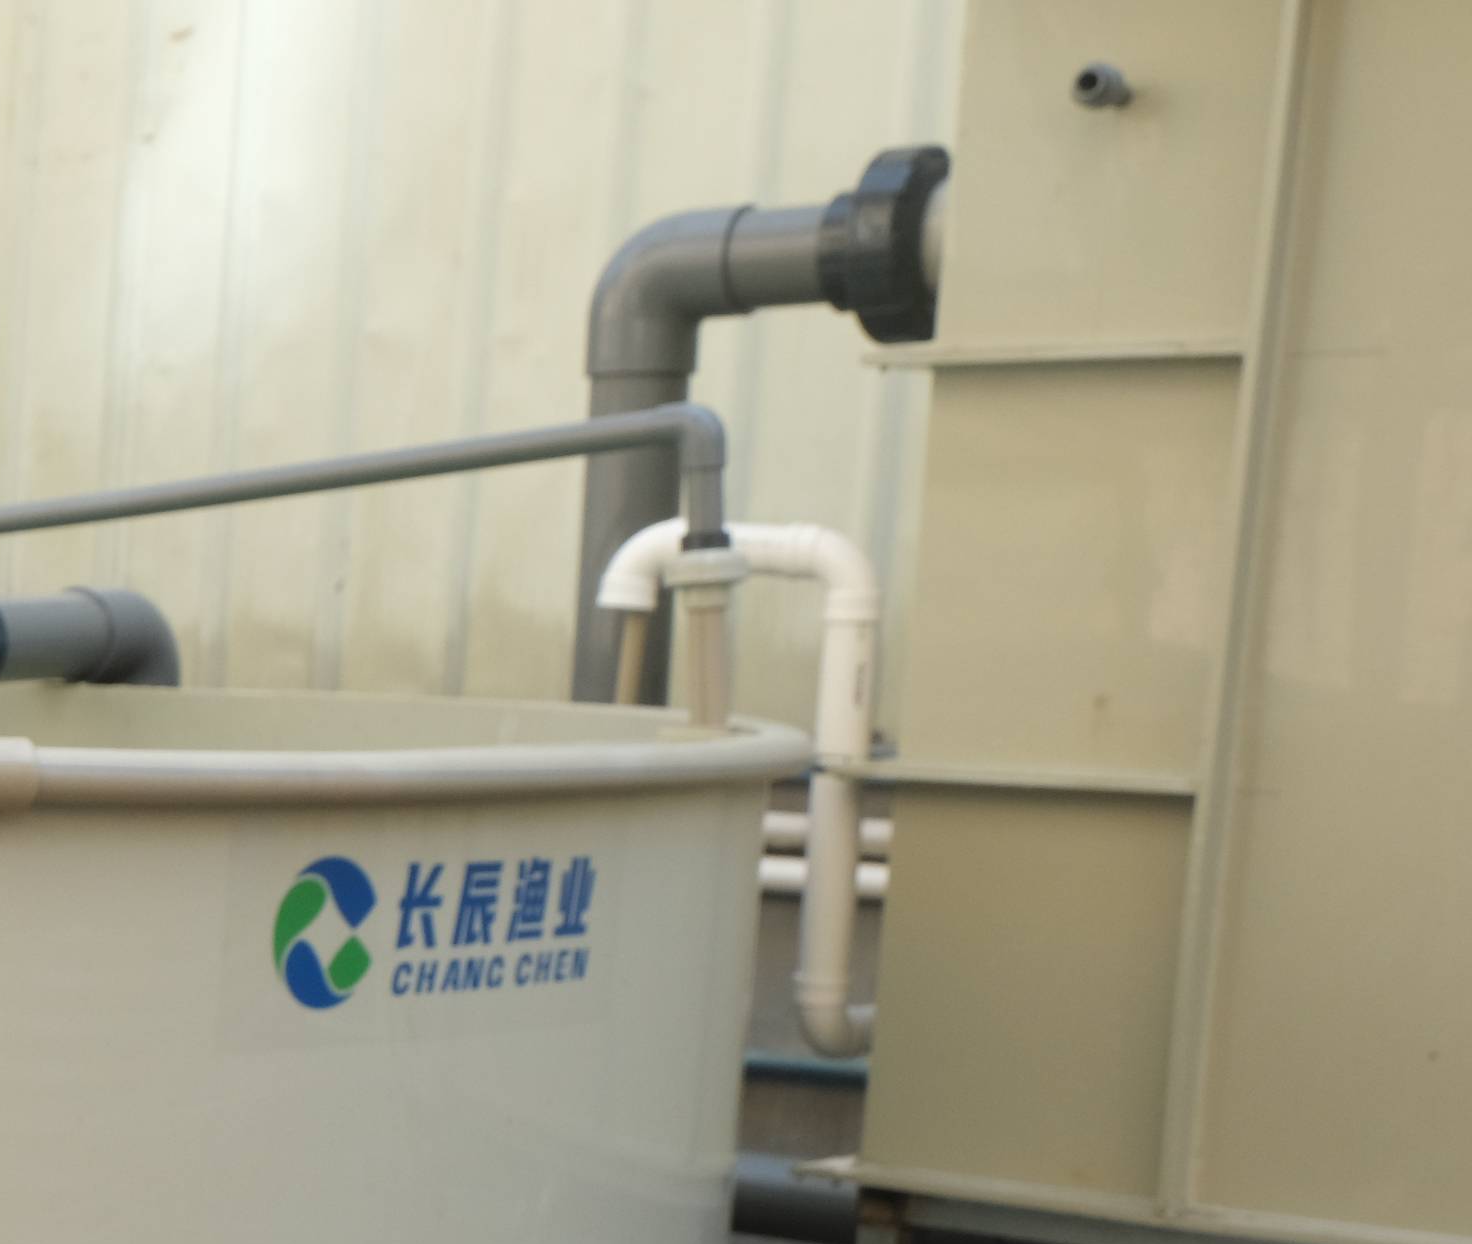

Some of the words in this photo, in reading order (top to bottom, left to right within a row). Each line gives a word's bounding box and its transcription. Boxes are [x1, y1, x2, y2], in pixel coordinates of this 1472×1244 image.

[396, 856, 596, 948] 长辰渔业
[514, 947, 591, 988] CHEN
